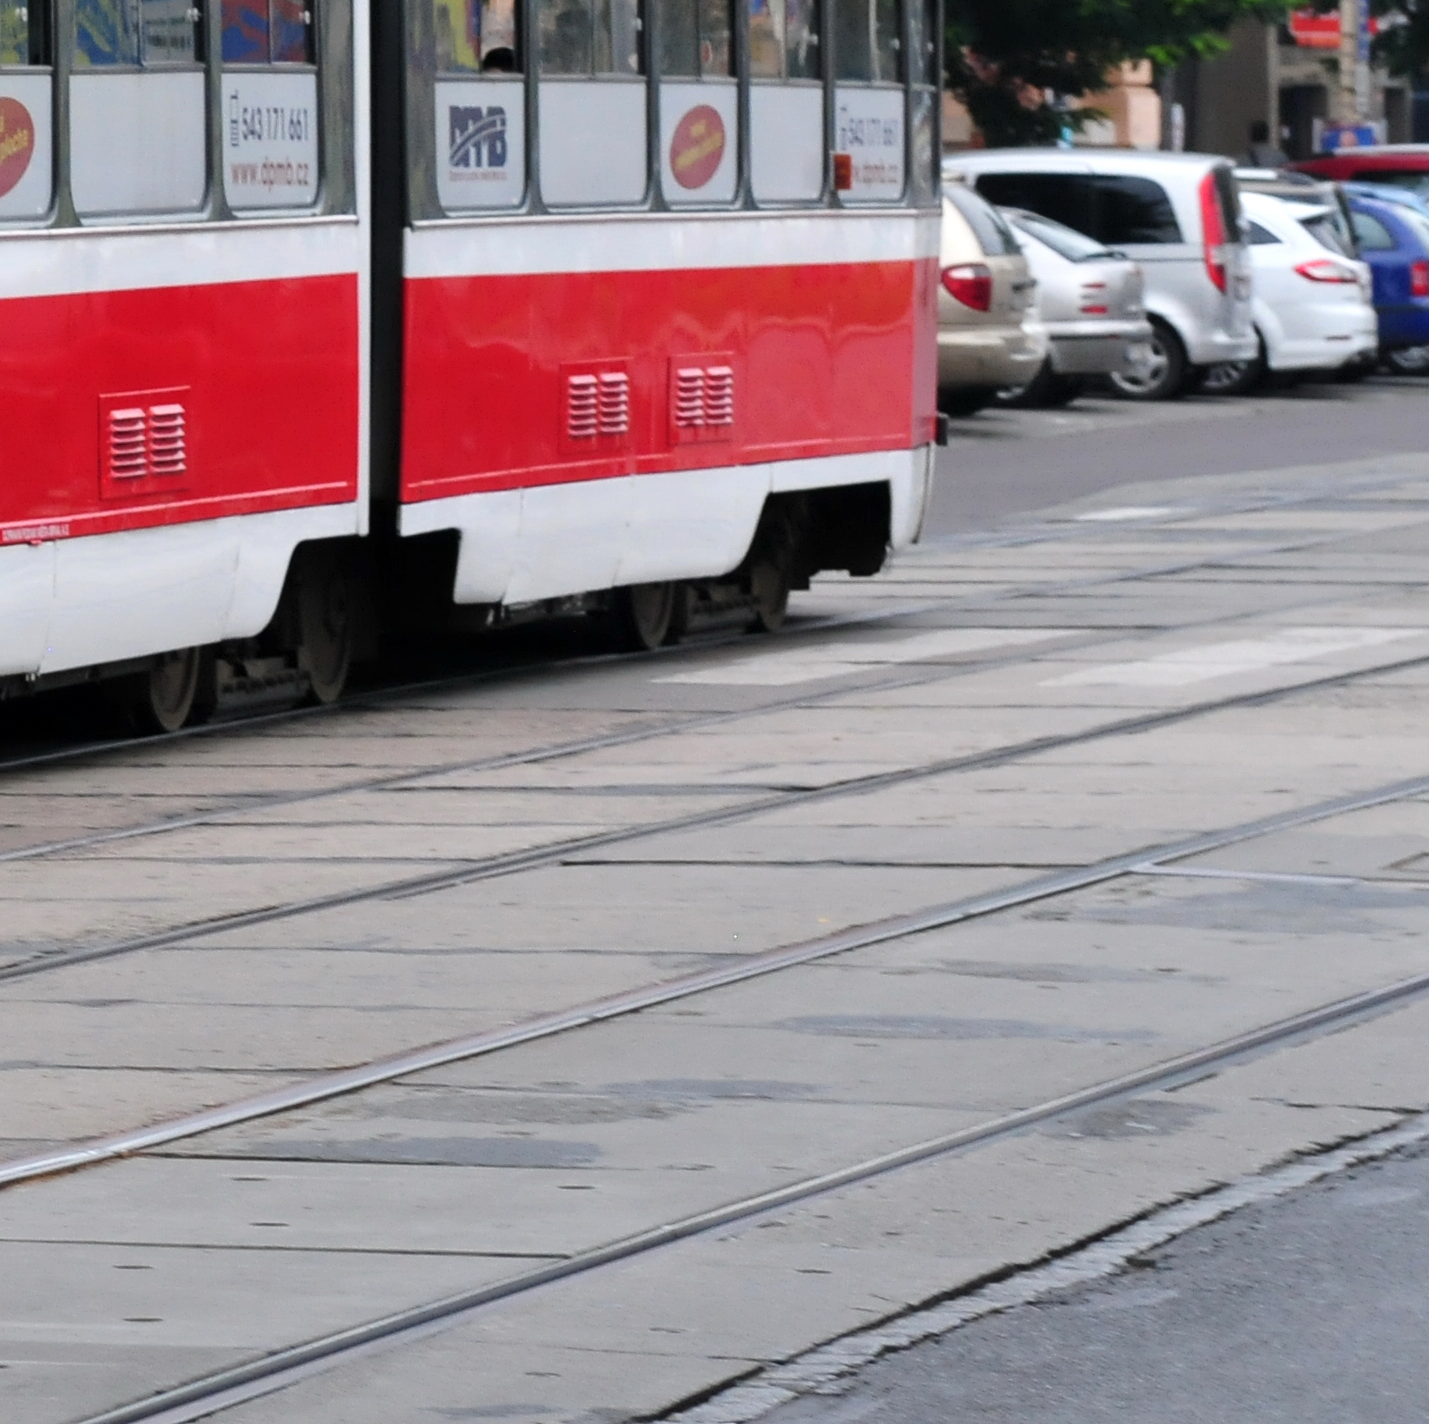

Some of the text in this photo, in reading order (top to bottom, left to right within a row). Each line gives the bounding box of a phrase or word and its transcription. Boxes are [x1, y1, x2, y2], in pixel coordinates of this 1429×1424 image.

[242, 107, 308, 141] 543 171 661
